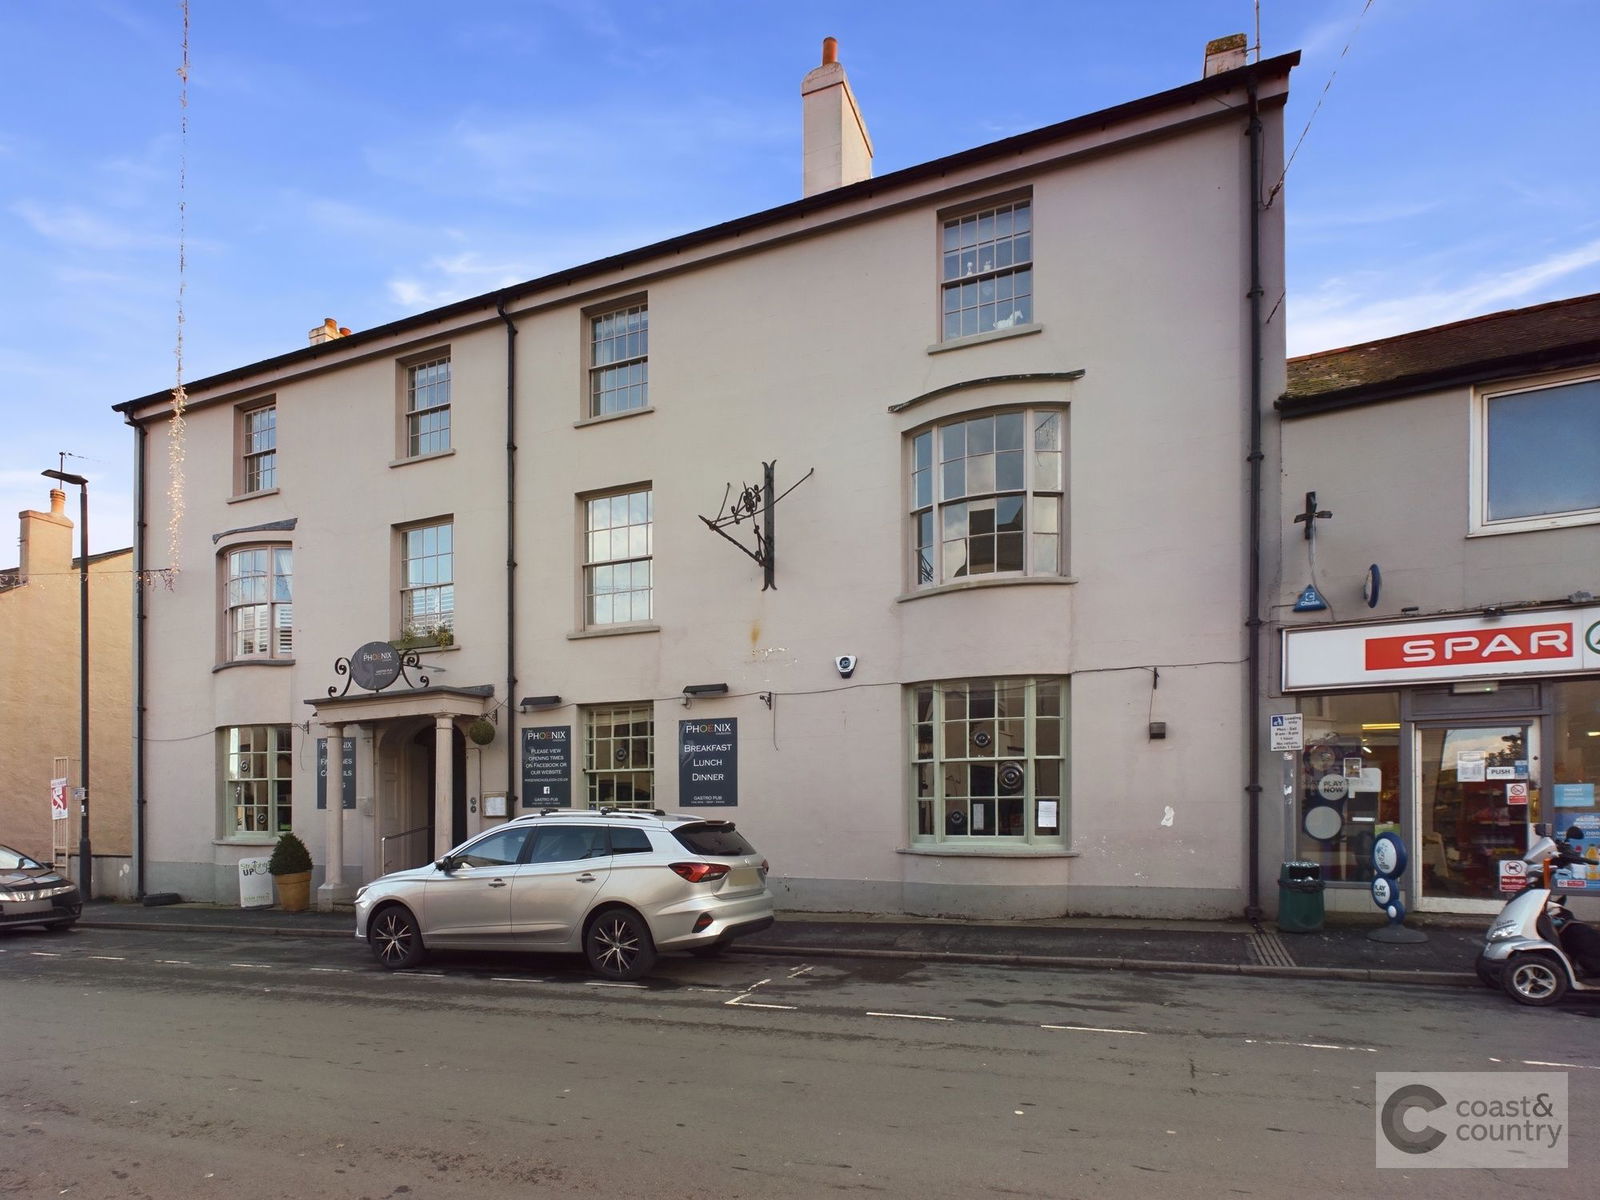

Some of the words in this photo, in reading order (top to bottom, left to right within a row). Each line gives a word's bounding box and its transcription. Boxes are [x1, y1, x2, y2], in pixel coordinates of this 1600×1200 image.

[1403, 630, 1568, 662] SPAR
[363, 652, 392, 661] PHOENIX
[686, 723, 731, 733] PHOENIX
[527, 731, 566, 740] PHOENIX
[684, 744, 732, 752] BREAKFAST
[694, 758, 722, 766] LUNCH
[692, 773, 724, 782] DINNER
